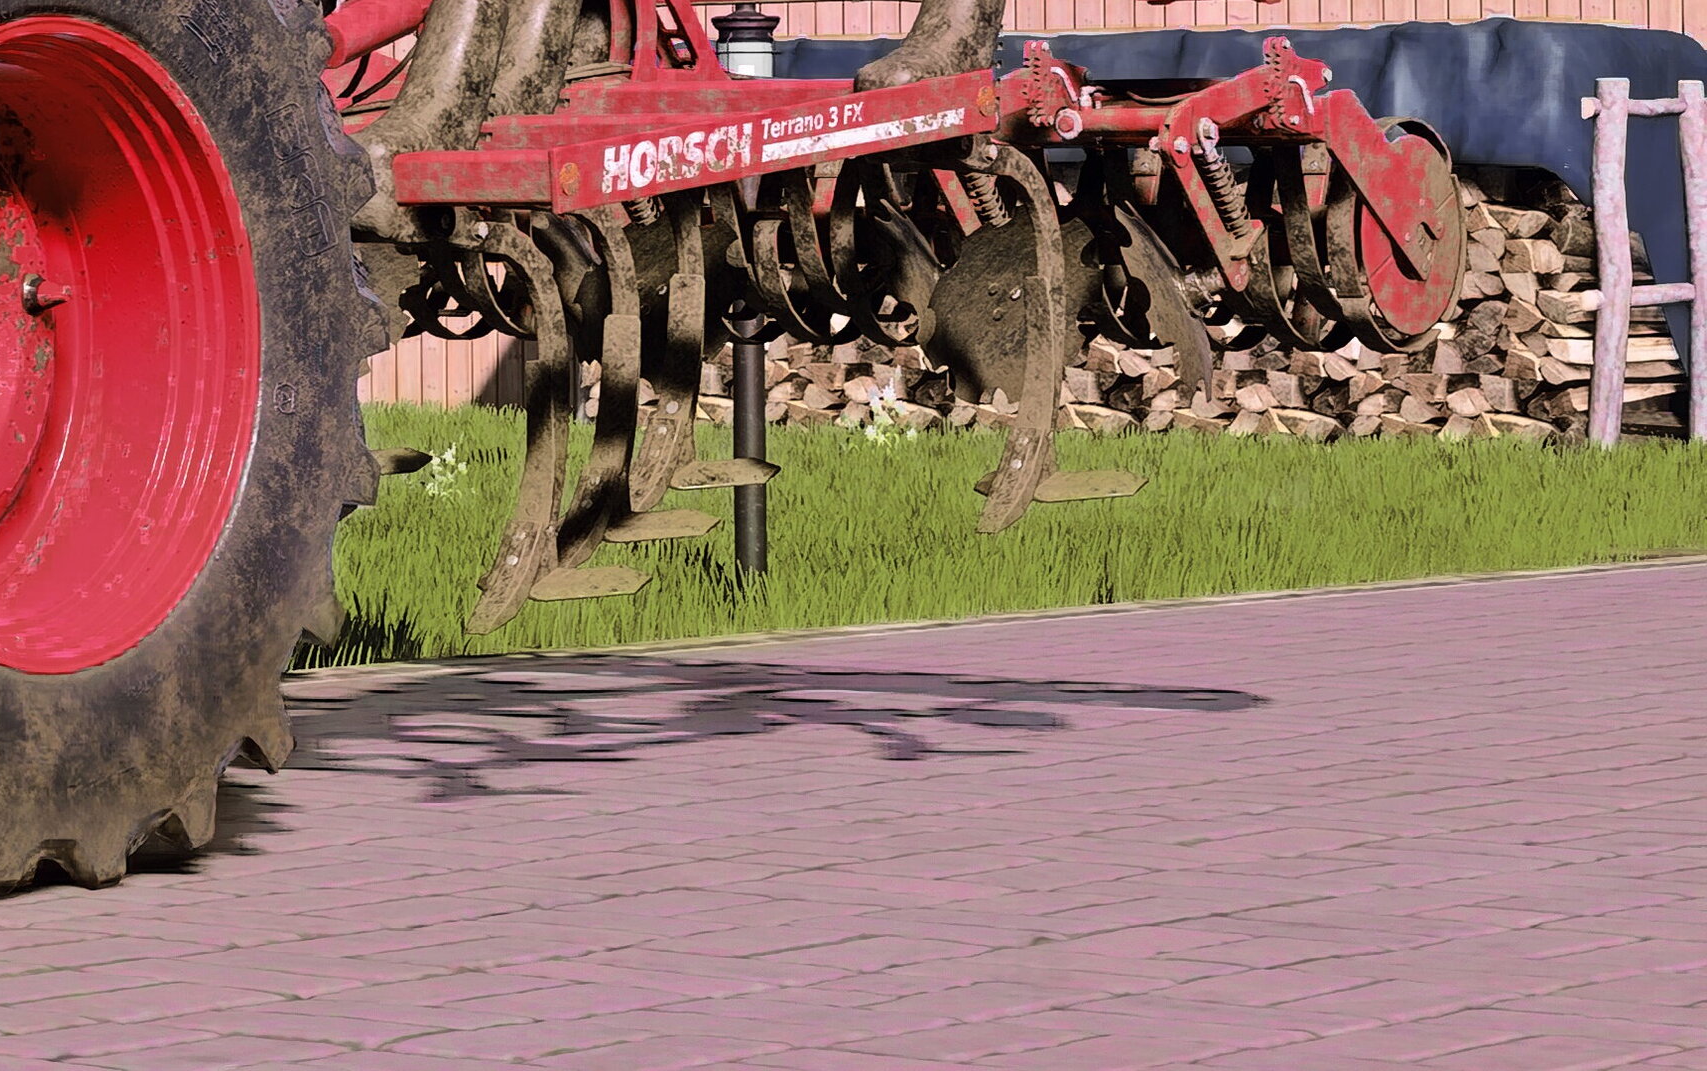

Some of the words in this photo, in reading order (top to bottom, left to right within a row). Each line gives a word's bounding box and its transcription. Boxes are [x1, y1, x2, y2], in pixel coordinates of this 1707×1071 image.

[761, 109, 824, 140] Terrano
[828, 107, 839, 128] 3
[843, 102, 865, 124] FX
[601, 122, 753, 194] HORSCH
